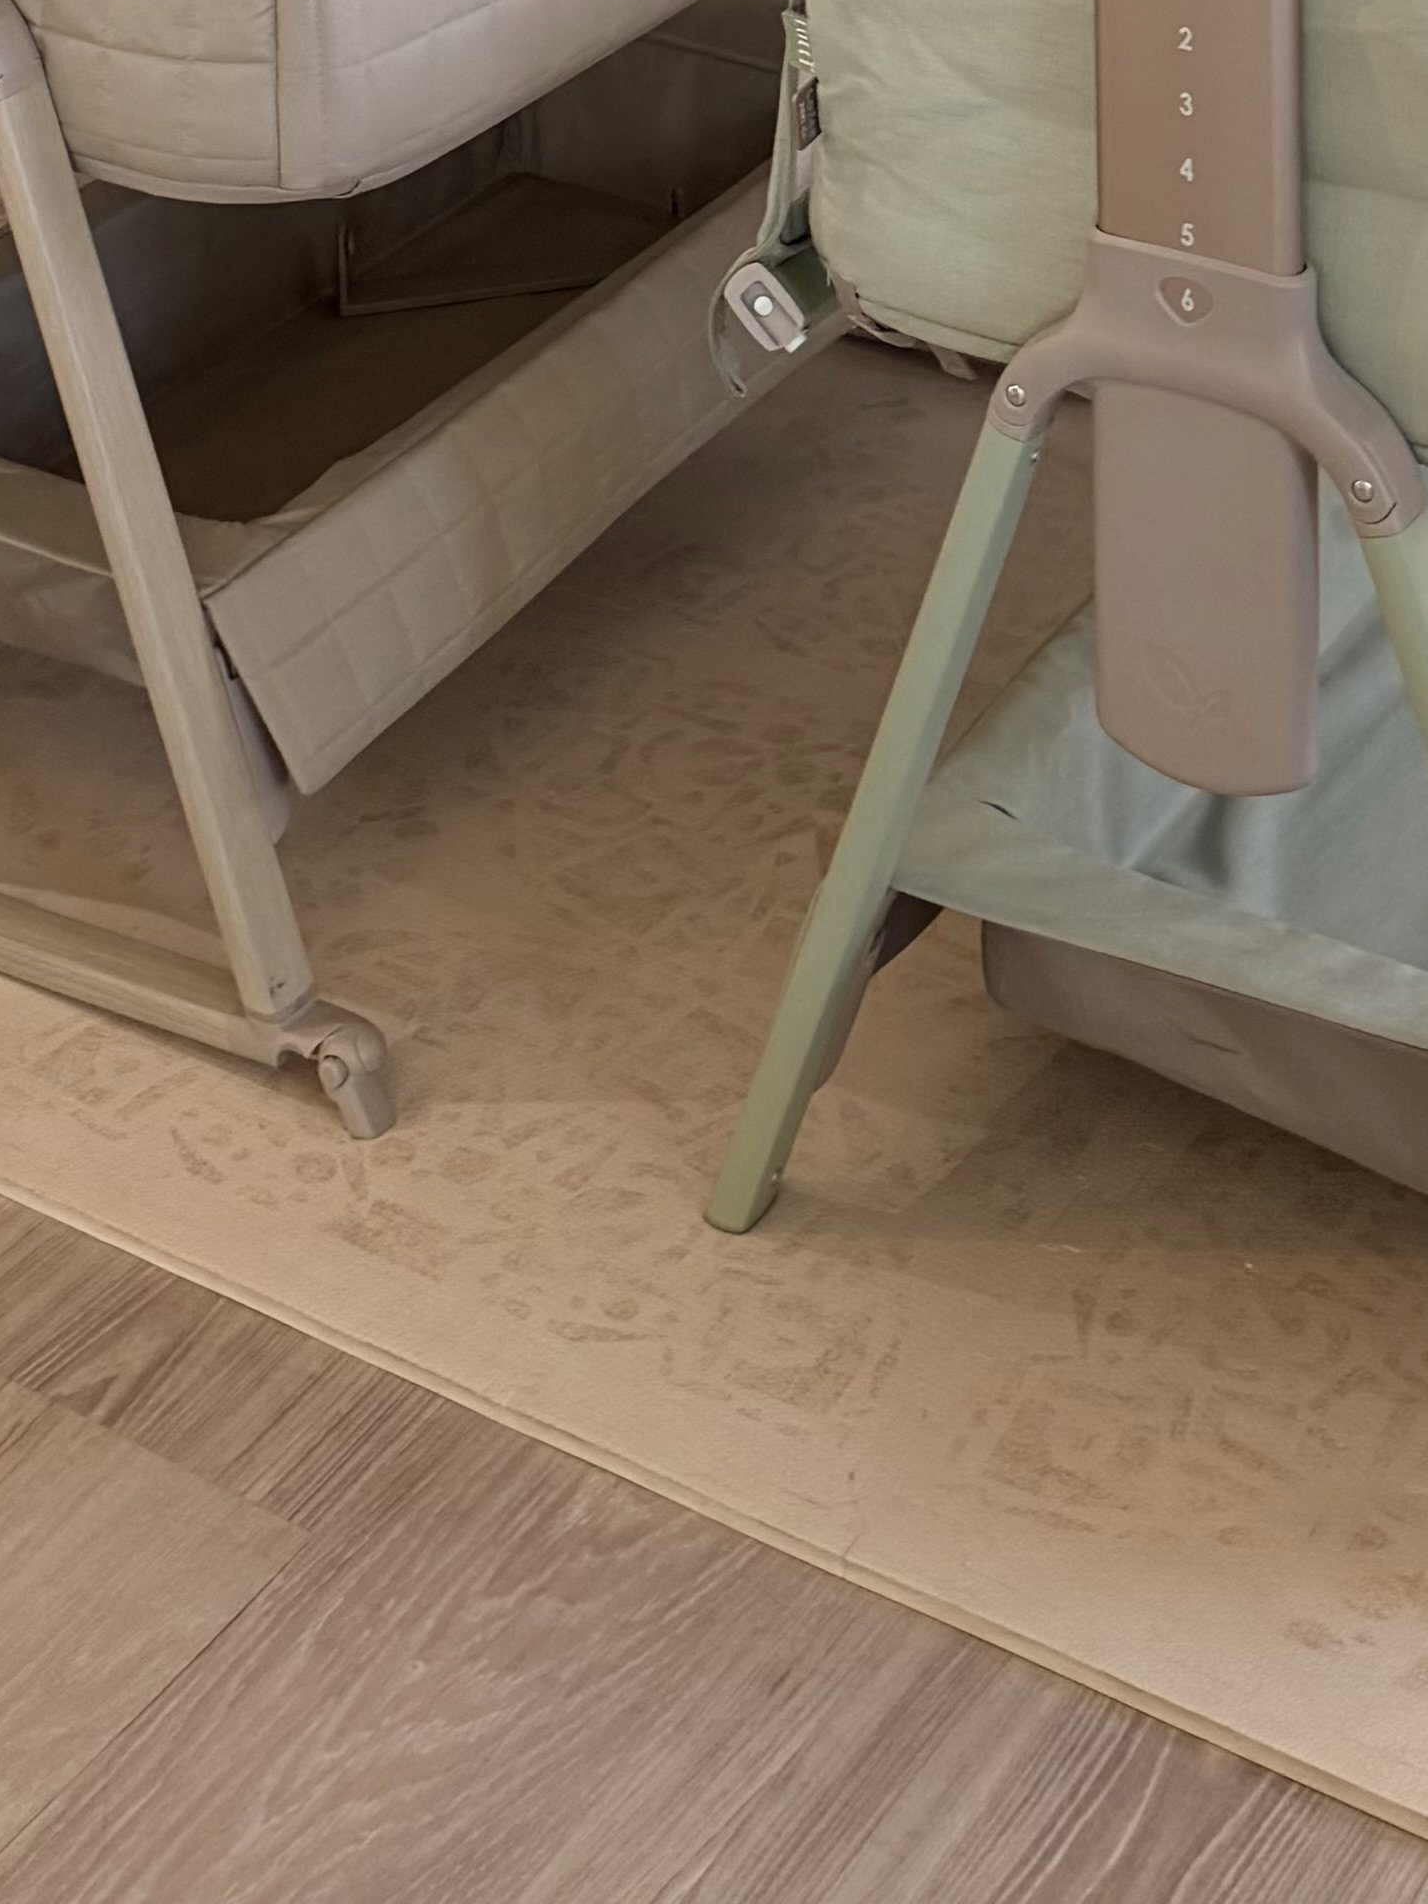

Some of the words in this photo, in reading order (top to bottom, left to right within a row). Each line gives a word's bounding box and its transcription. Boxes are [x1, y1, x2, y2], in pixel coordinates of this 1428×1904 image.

[1178, 26, 1193, 51] 2
[1179, 92, 1194, 116] 3
[1179, 158, 1194, 182] 4
[1180, 223, 1194, 246] 5
[1180, 288, 1194, 311] 6
